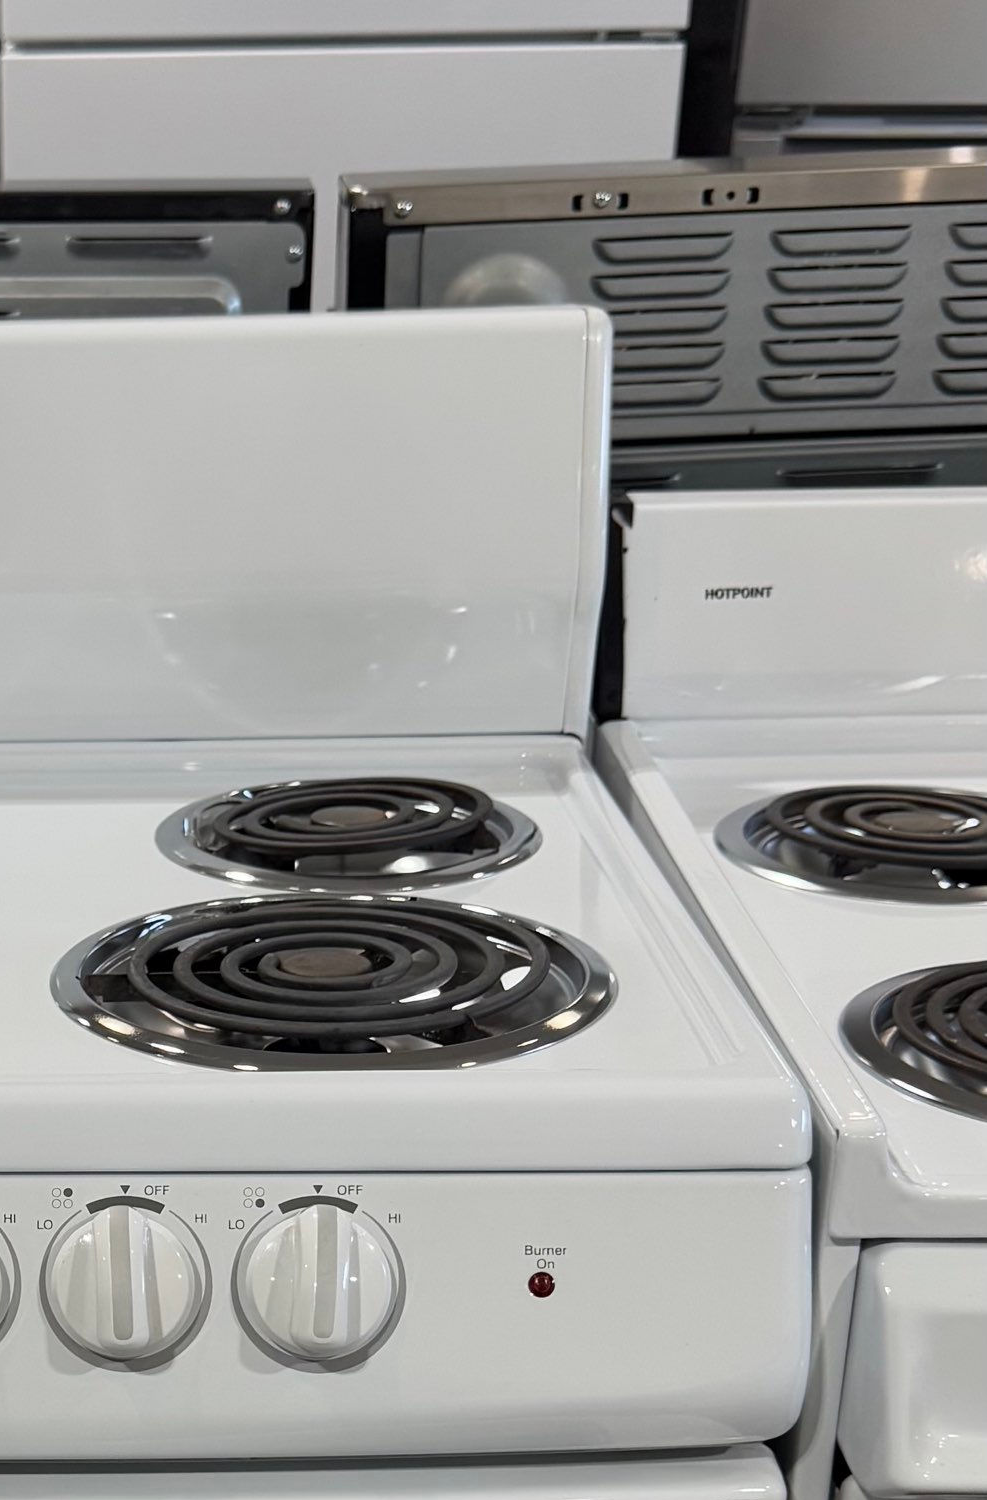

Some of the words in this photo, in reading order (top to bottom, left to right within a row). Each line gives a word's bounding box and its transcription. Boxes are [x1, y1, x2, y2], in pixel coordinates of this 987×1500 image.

[704, 586, 773, 600] HOTPOINT
[143, 1185, 170, 1196] OFF
[336, 1185, 364, 1196] OFF
[3, 1213, 17, 1224] HI
[36, 1218, 54, 1230] LO
[194, 1213, 208, 1224] HI
[228, 1218, 245, 1230] LO
[388, 1213, 401, 1224] HI
[524, 1244, 567, 1256] Burner
[536, 1258, 555, 1269] On
